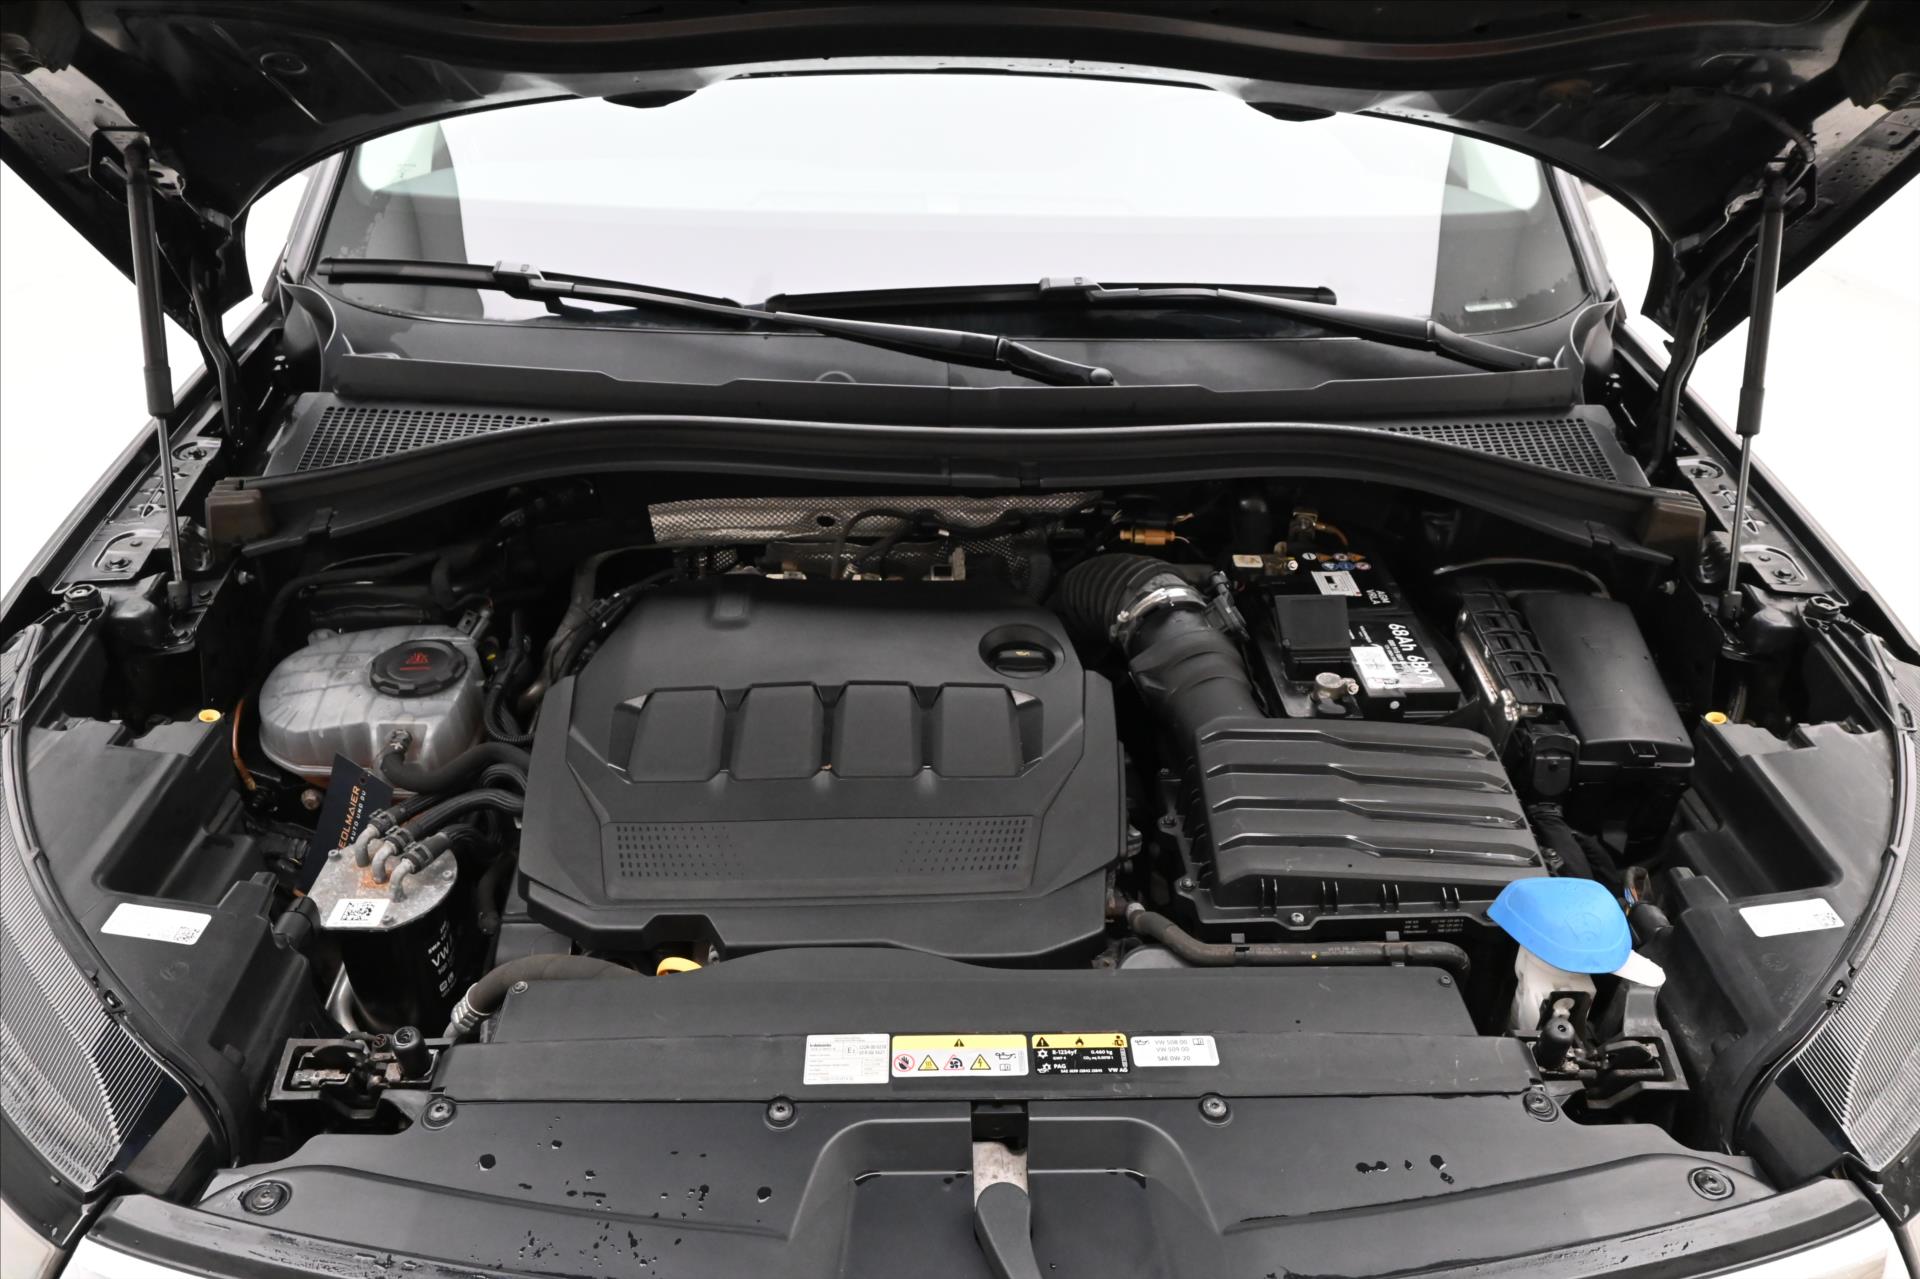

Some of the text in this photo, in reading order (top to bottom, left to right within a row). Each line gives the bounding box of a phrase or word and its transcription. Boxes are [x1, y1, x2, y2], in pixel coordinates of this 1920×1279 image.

[1366, 589, 1381, 605] VRLA
[1376, 590, 1391, 603] AGM
[1388, 623, 1417, 651] 68Ah
[1407, 655, 1438, 684] 680A
